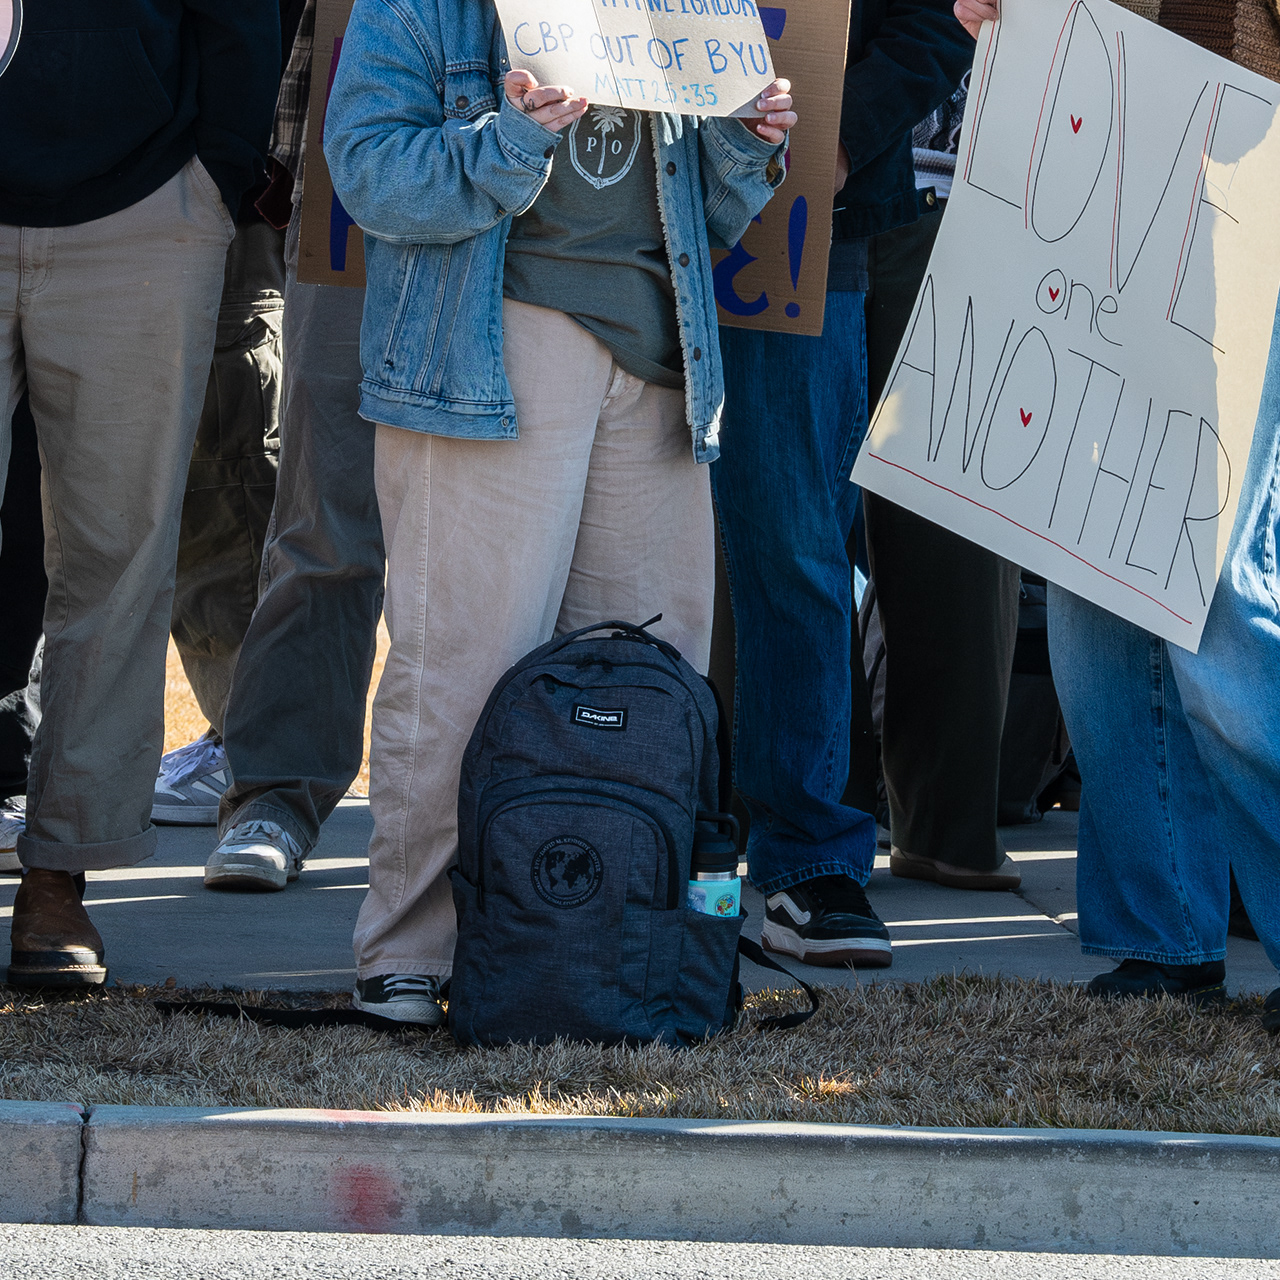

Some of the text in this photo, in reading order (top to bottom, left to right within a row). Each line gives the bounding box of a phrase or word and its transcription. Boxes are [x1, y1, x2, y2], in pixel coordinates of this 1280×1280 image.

[513, 21, 768, 76] CBP OUT OF BYU
[595, 73, 718, 107] MATT 25:35
[866, 275, 1231, 607] ANOTHER
[581, 711, 618, 722] DAKINE
